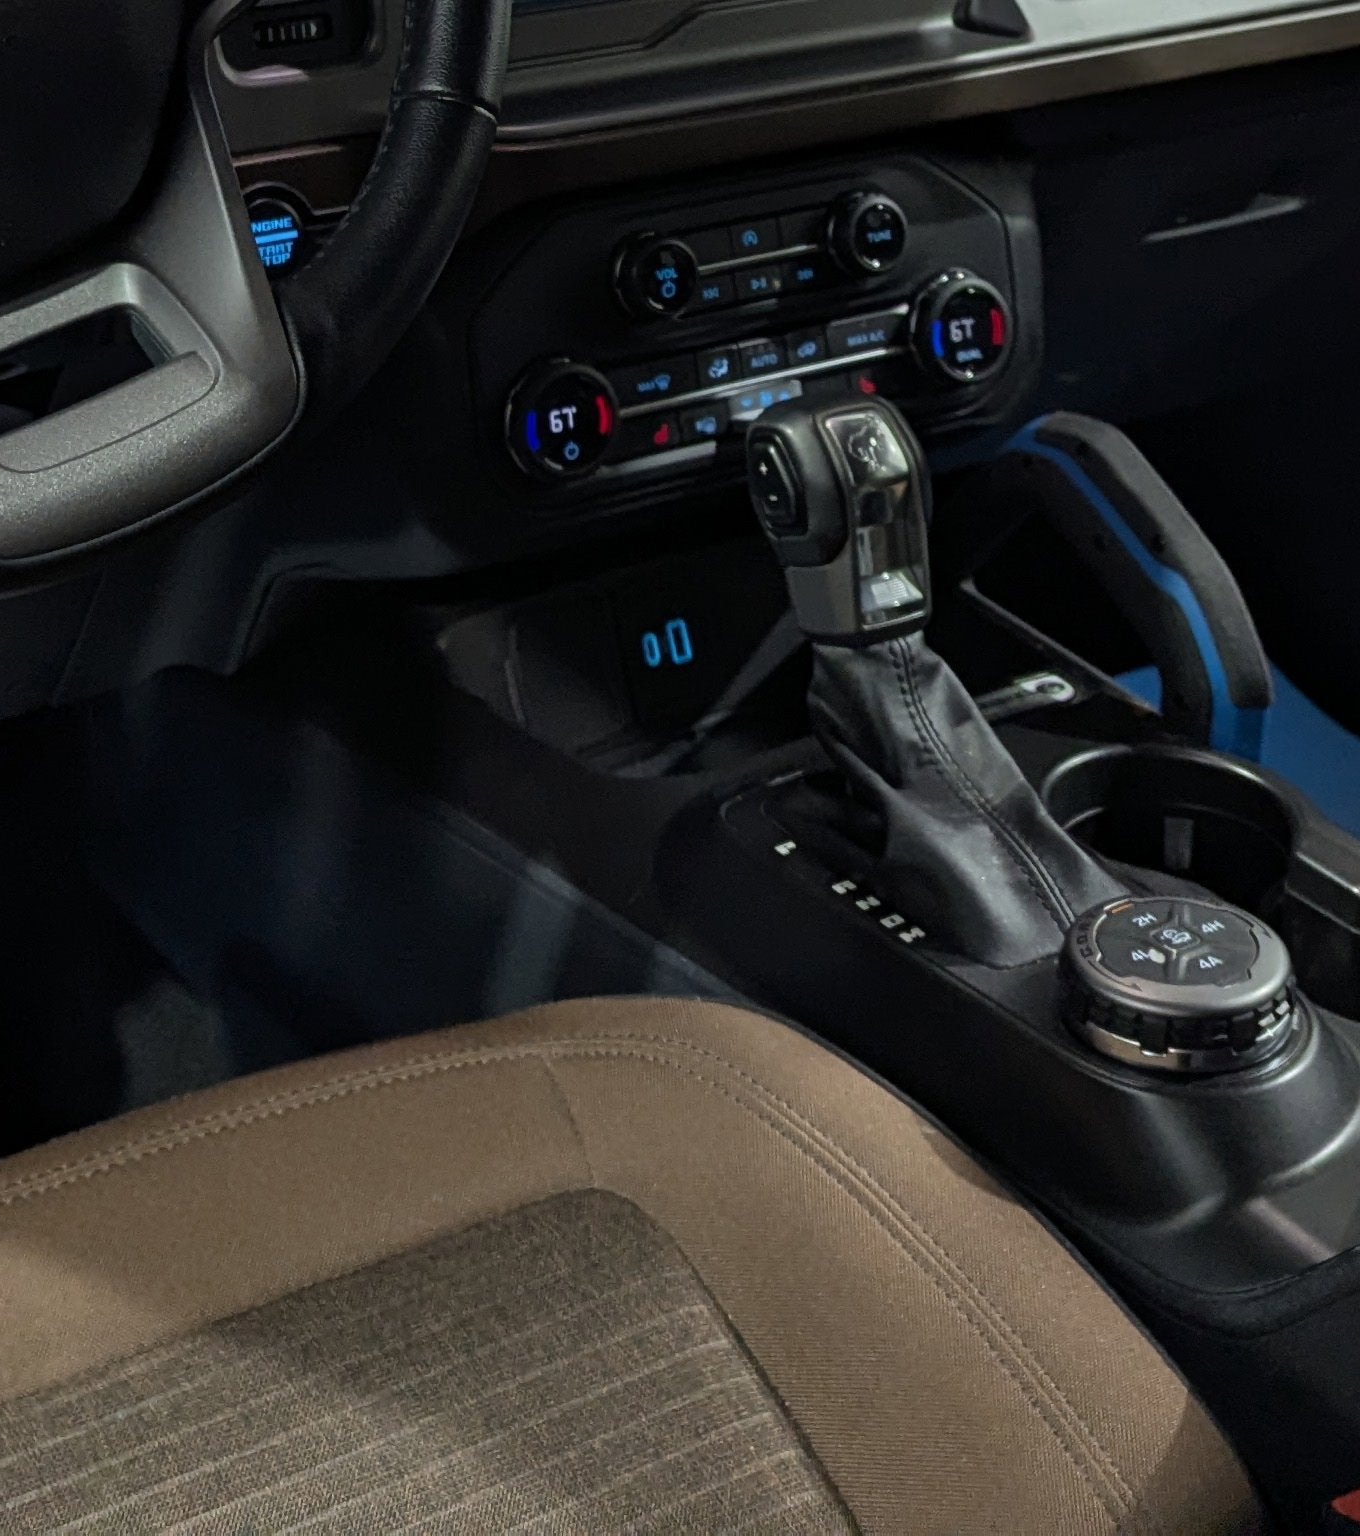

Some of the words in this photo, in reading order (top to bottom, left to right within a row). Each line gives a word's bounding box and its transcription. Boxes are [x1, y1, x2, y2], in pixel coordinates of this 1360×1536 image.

[250, 216, 293, 233] NGINE
[866, 229, 893, 244] TUNE
[656, 267, 679, 281] VOL
[750, 352, 779, 369] AUTO
[1131, 912, 1159, 928] 2H
[1200, 919, 1226, 934] 4H
[1198, 954, 1224, 970] 4A
